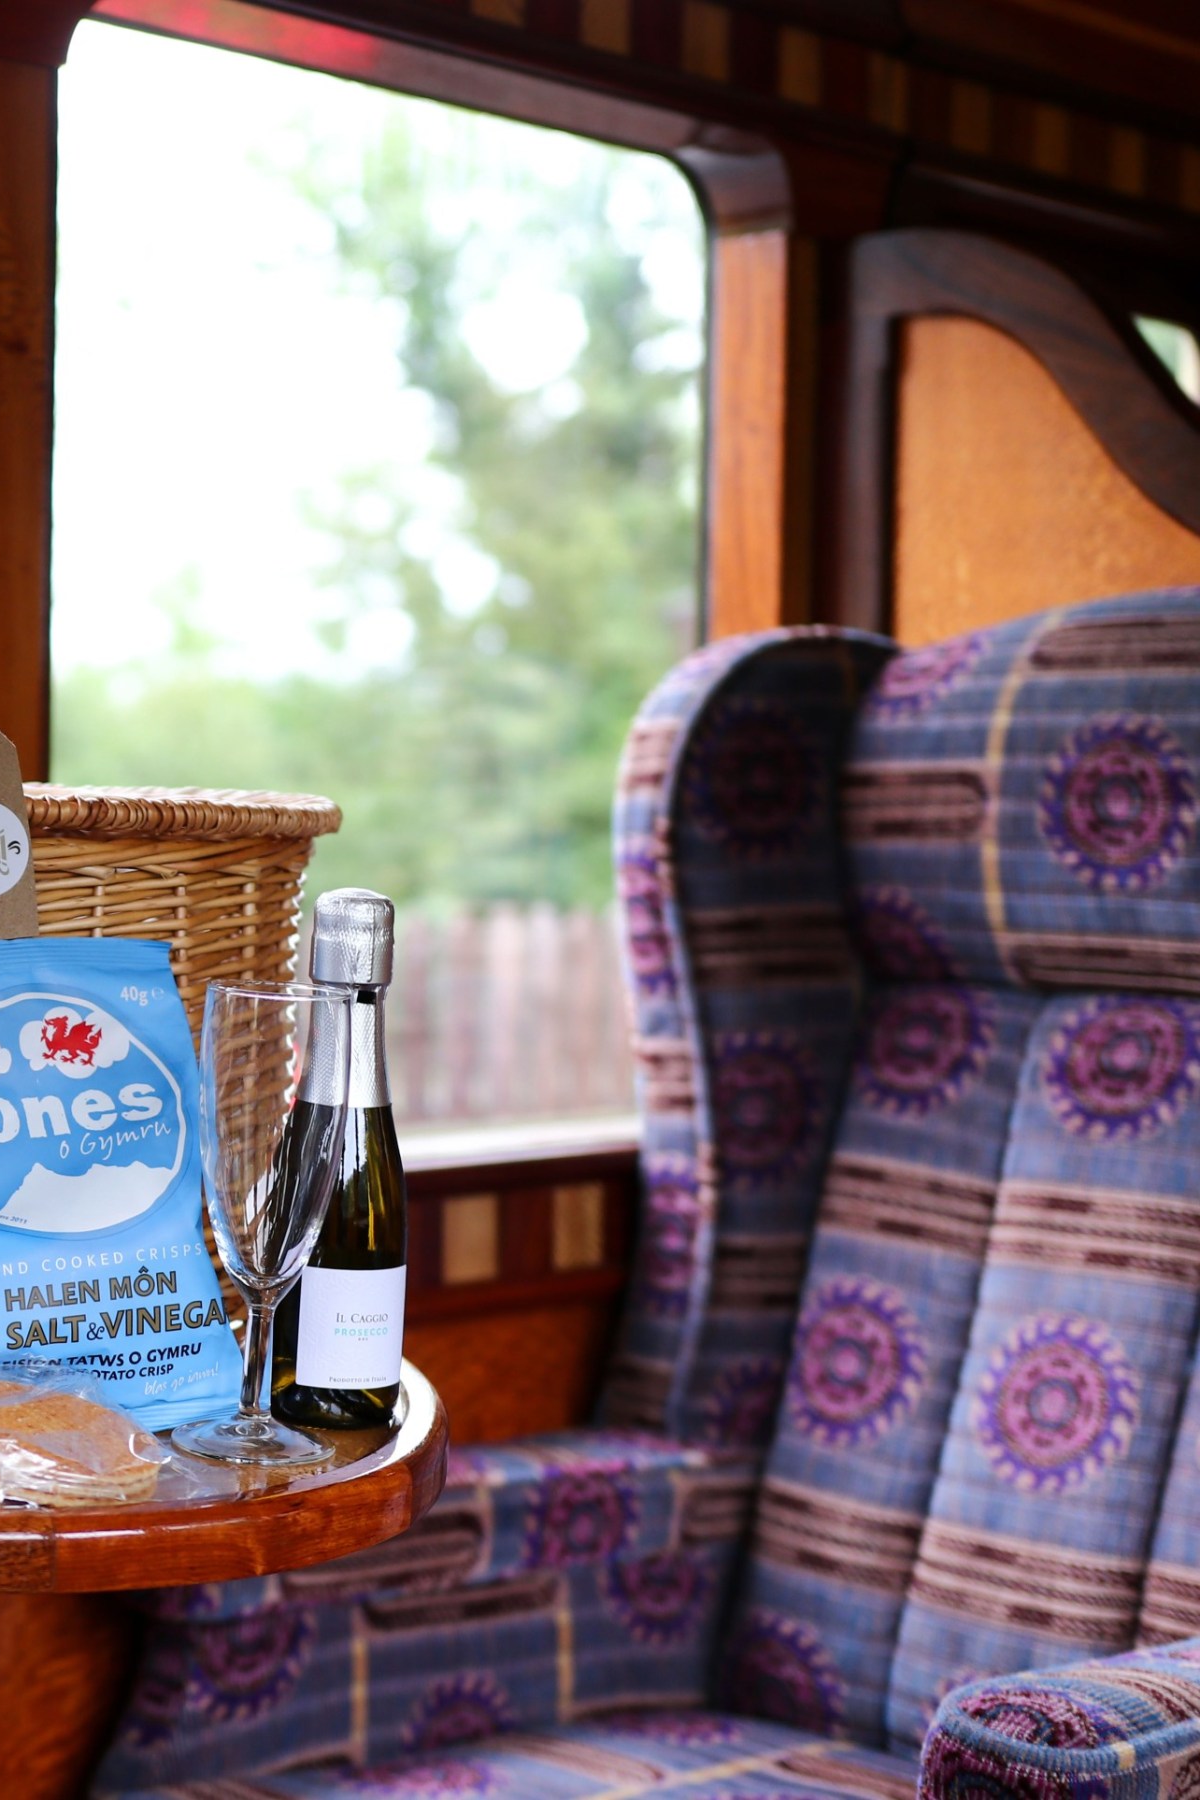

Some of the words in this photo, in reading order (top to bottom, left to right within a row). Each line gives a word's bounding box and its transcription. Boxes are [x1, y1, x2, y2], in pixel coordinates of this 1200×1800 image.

[120, 985, 148, 1006] 40g
[80, 1121, 171, 1160] Gymru
[42, 1252, 123, 1272] COOKED
[136, 1243, 202, 1262] CRISPS
[4, 1279, 100, 1312] HALEN
[109, 1266, 177, 1301] MÔN
[334, 1327, 388, 1337] PROSECCO
[67, 1353, 124, 1367] TATWS
[128, 1351, 142, 1365] O
[146, 1342, 202, 1363] GYMRU
[77, 1368, 136, 1381] OTATO
[139, 1363, 174, 1378] CRISP
[144, 1380, 167, 1396] blas
